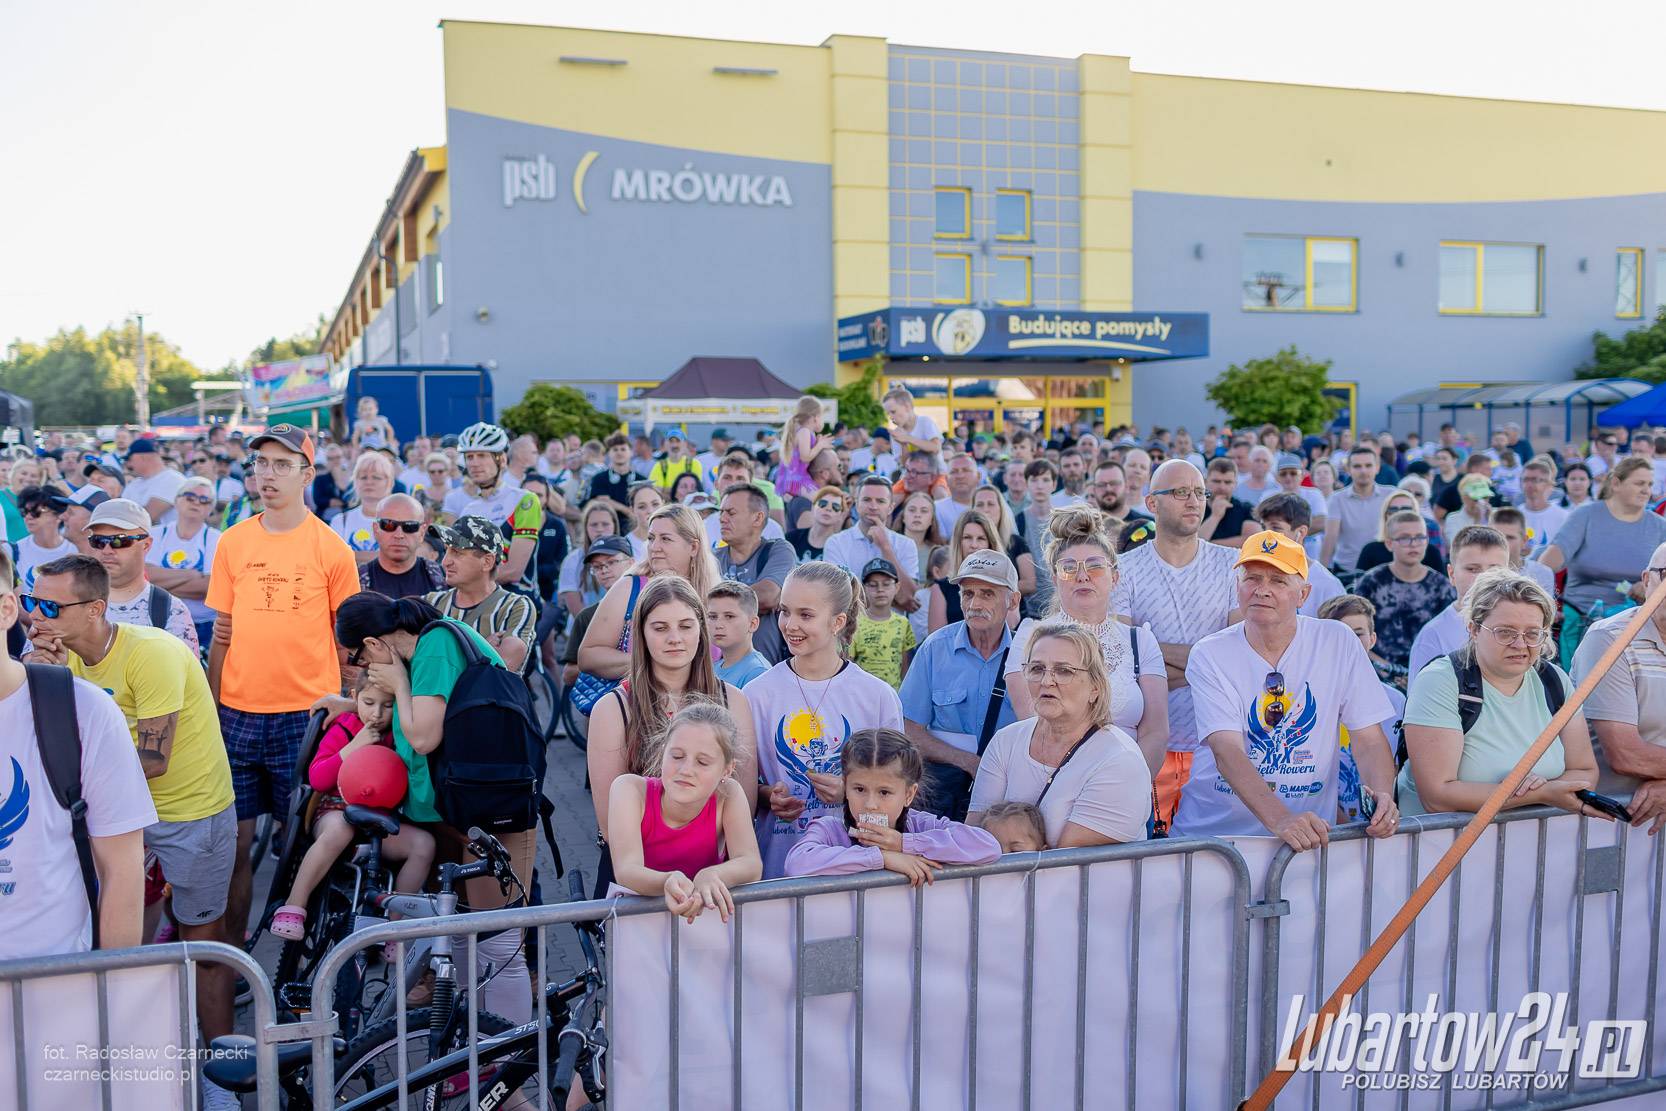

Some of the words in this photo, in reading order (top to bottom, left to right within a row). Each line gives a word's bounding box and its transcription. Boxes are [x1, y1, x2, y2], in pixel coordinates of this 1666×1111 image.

[503, 154, 557, 207] psb
[611, 163, 794, 207] MRÓWKA
[1008, 314, 1092, 338] Budujące
[1095, 316, 1172, 341] pomysły
[1278, 763, 1316, 775] Roweru
